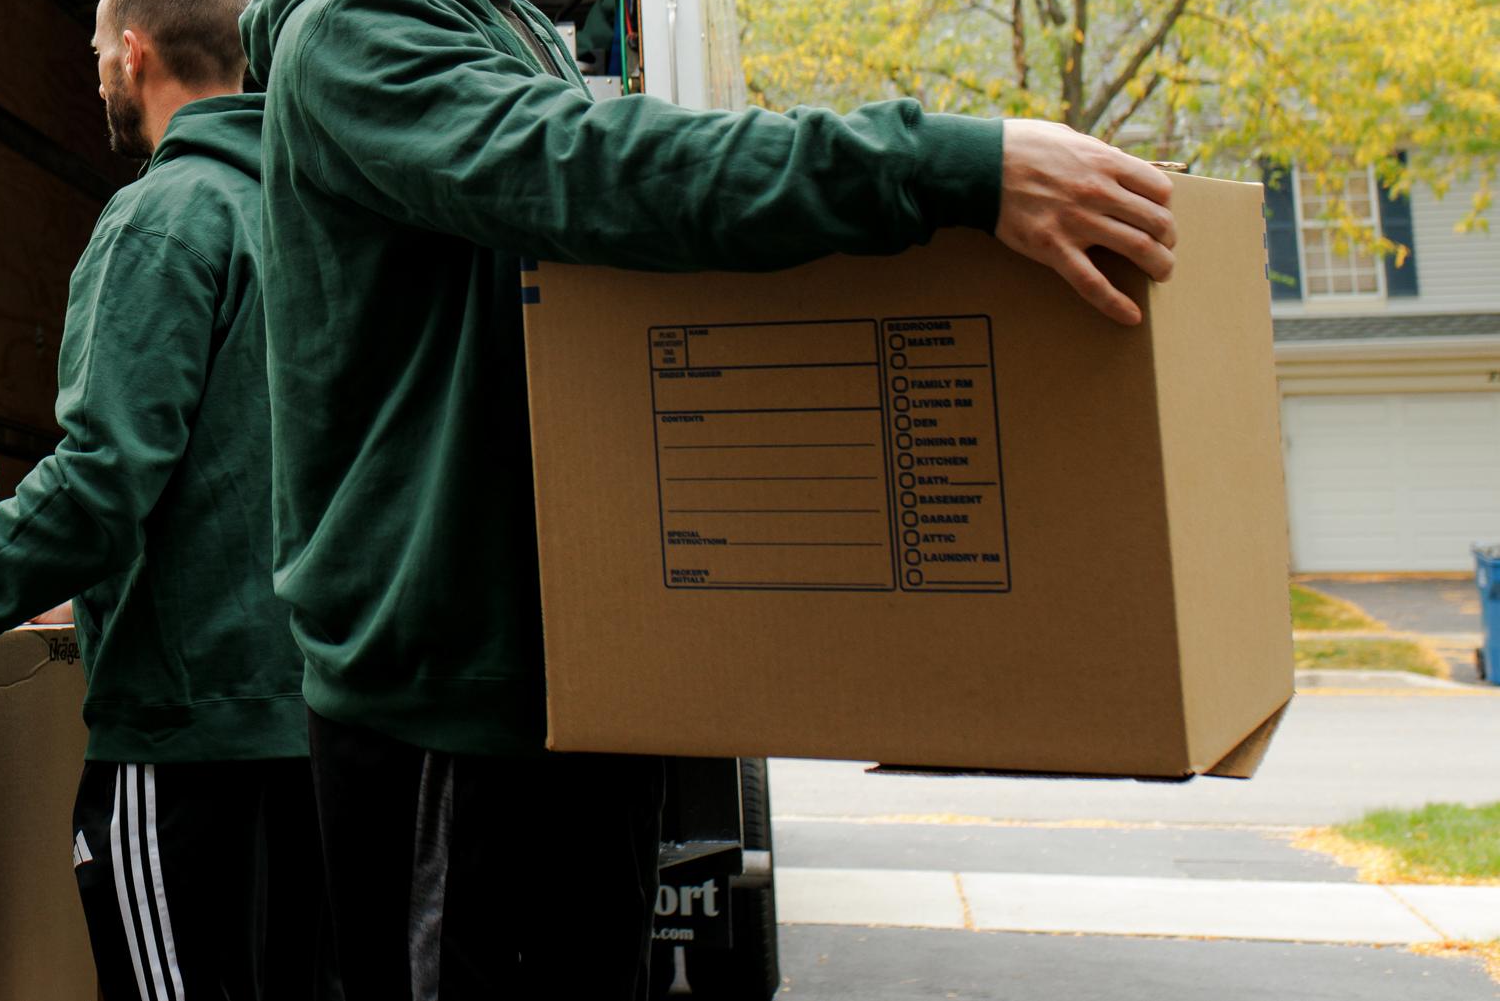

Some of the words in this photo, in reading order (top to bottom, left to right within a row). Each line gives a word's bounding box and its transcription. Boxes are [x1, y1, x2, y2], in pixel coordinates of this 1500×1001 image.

[887, 321, 952, 332] BEDROOMS
[907, 337, 956, 347] MASTER
[911, 379, 952, 389] FAMILY
[955, 379, 974, 388] RM
[912, 399, 952, 409] LIVING
[954, 398, 974, 408] RM
[661, 415, 705, 423] CONTENTS
[913, 418, 938, 428] DEN
[914, 437, 956, 447] DINING
[959, 437, 978, 446] RM
[916, 456, 969, 466] KITCHEN
[918, 476, 949, 486] BATH
[919, 495, 983, 505] BASEMENT
[920, 514, 969, 524] GARAGE
[922, 533, 956, 543] ATTIC
[924, 553, 978, 563] LAUNDRY
[981, 553, 1000, 563] RM
